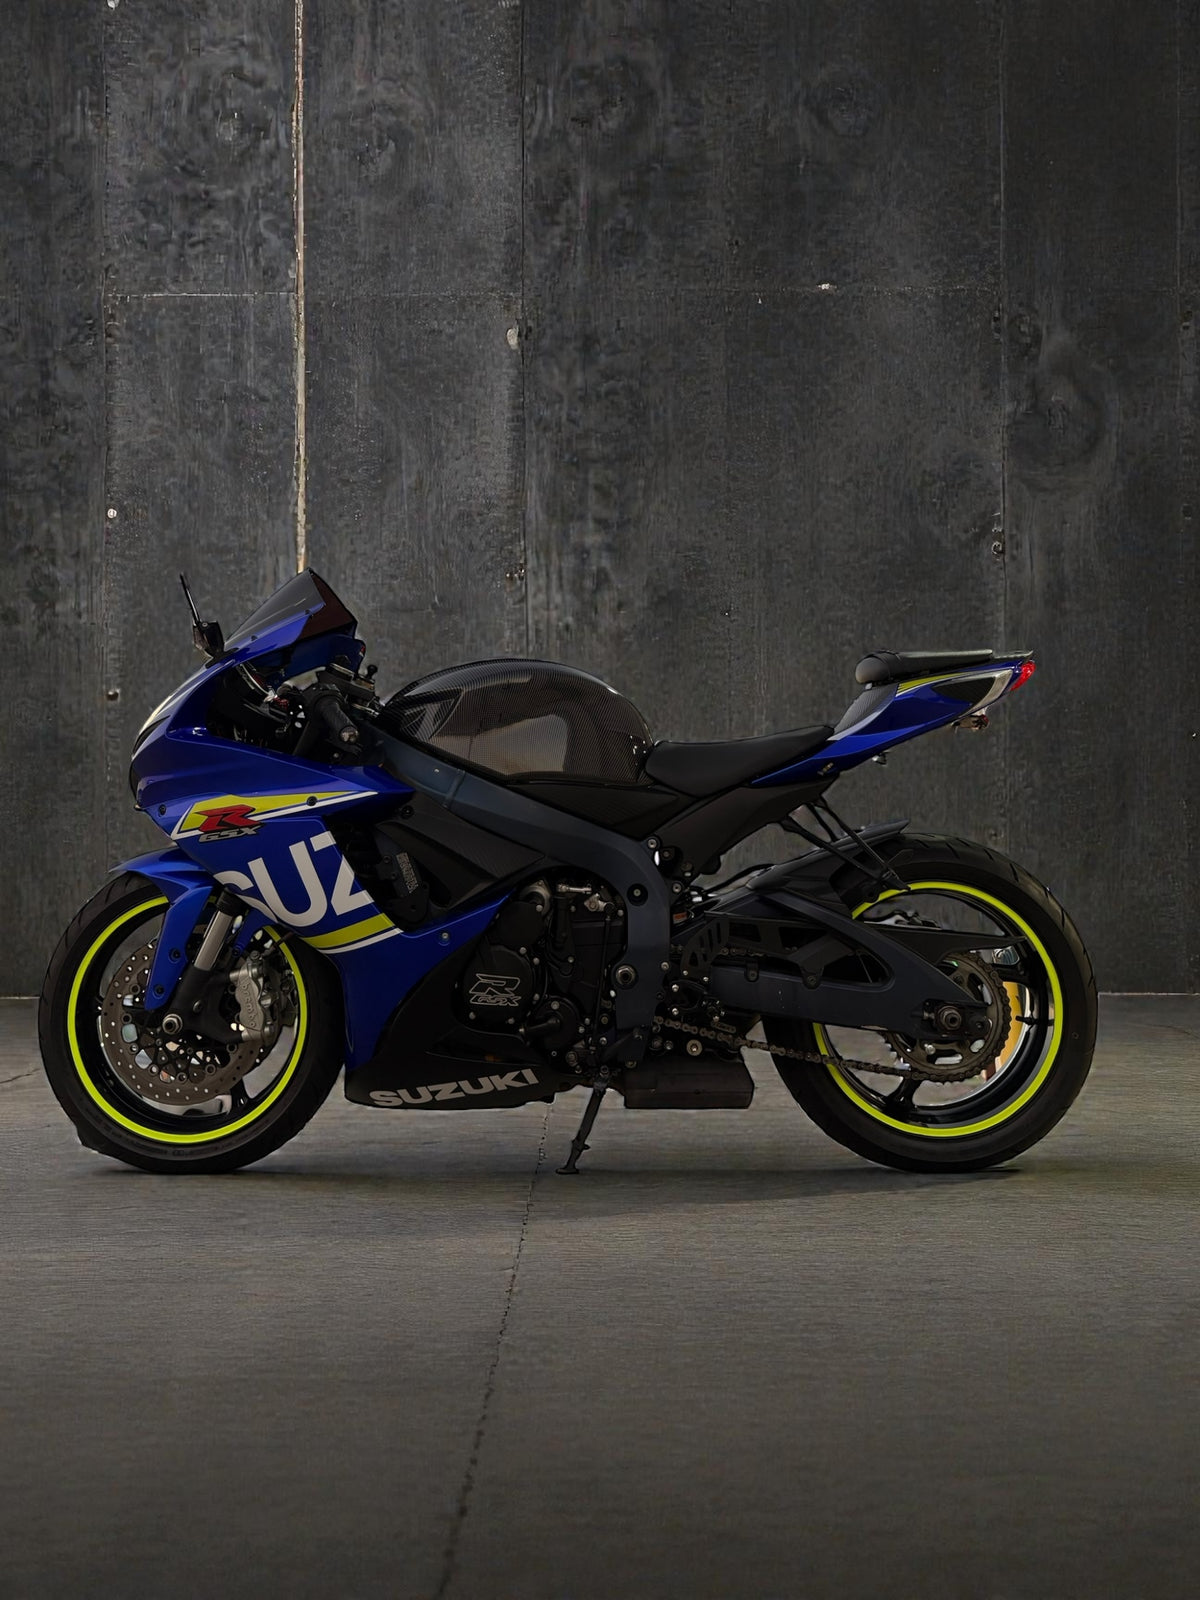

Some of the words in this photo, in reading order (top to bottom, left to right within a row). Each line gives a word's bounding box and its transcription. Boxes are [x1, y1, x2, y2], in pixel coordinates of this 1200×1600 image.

[195, 804, 263, 832] R
[199, 825, 264, 843] GSX
[469, 973, 521, 996] R
[241, 982, 259, 1028] brembo
[469, 994, 522, 1007] GSX
[369, 1068, 540, 1107] SUZUKI
